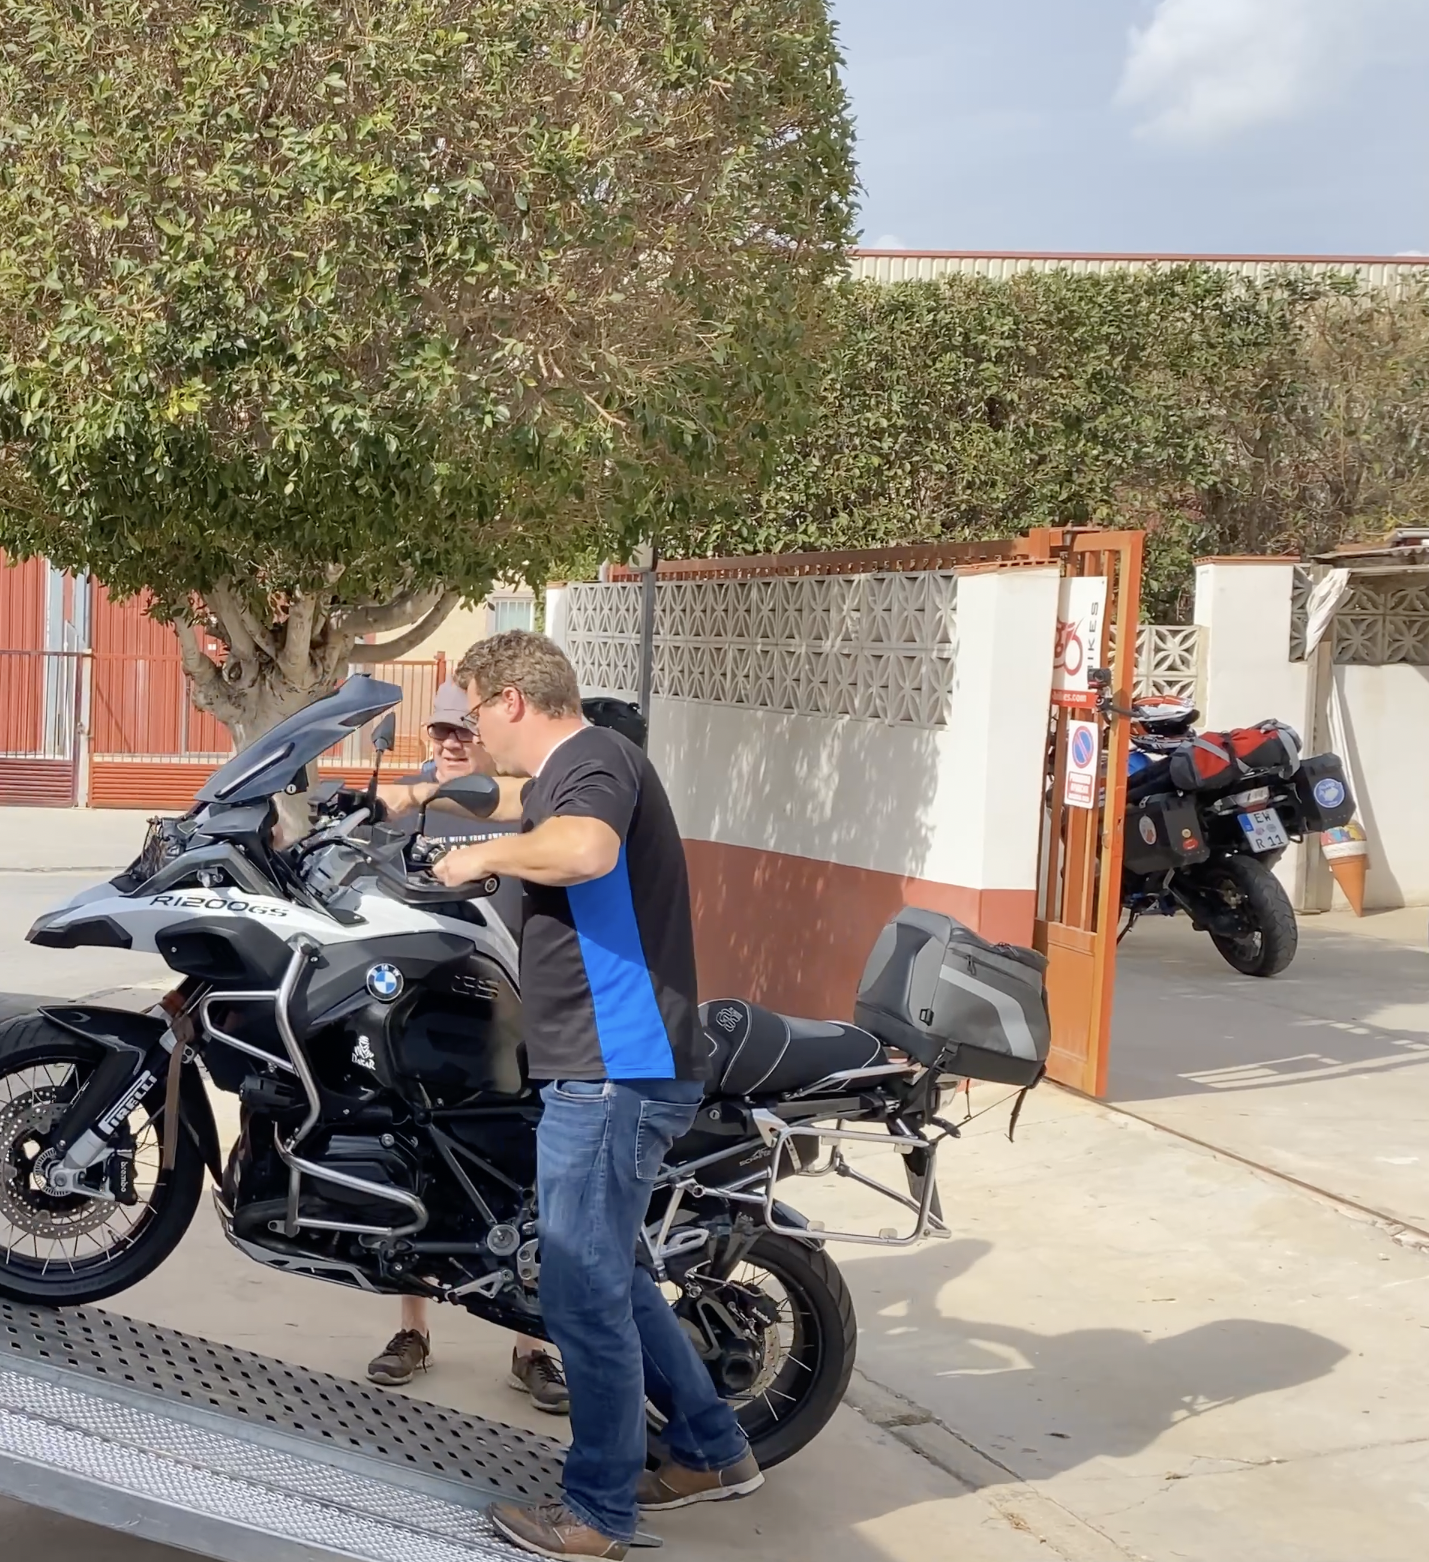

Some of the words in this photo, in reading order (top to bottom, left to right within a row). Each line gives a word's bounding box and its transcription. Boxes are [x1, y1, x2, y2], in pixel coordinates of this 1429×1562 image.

[1253, 810, 1272, 824] EW
[1267, 834, 1285, 847] 11
[450, 974, 501, 1000] GS
[97, 1069, 158, 1136] PIRELLI
[120, 1160, 129, 1193] brembo
